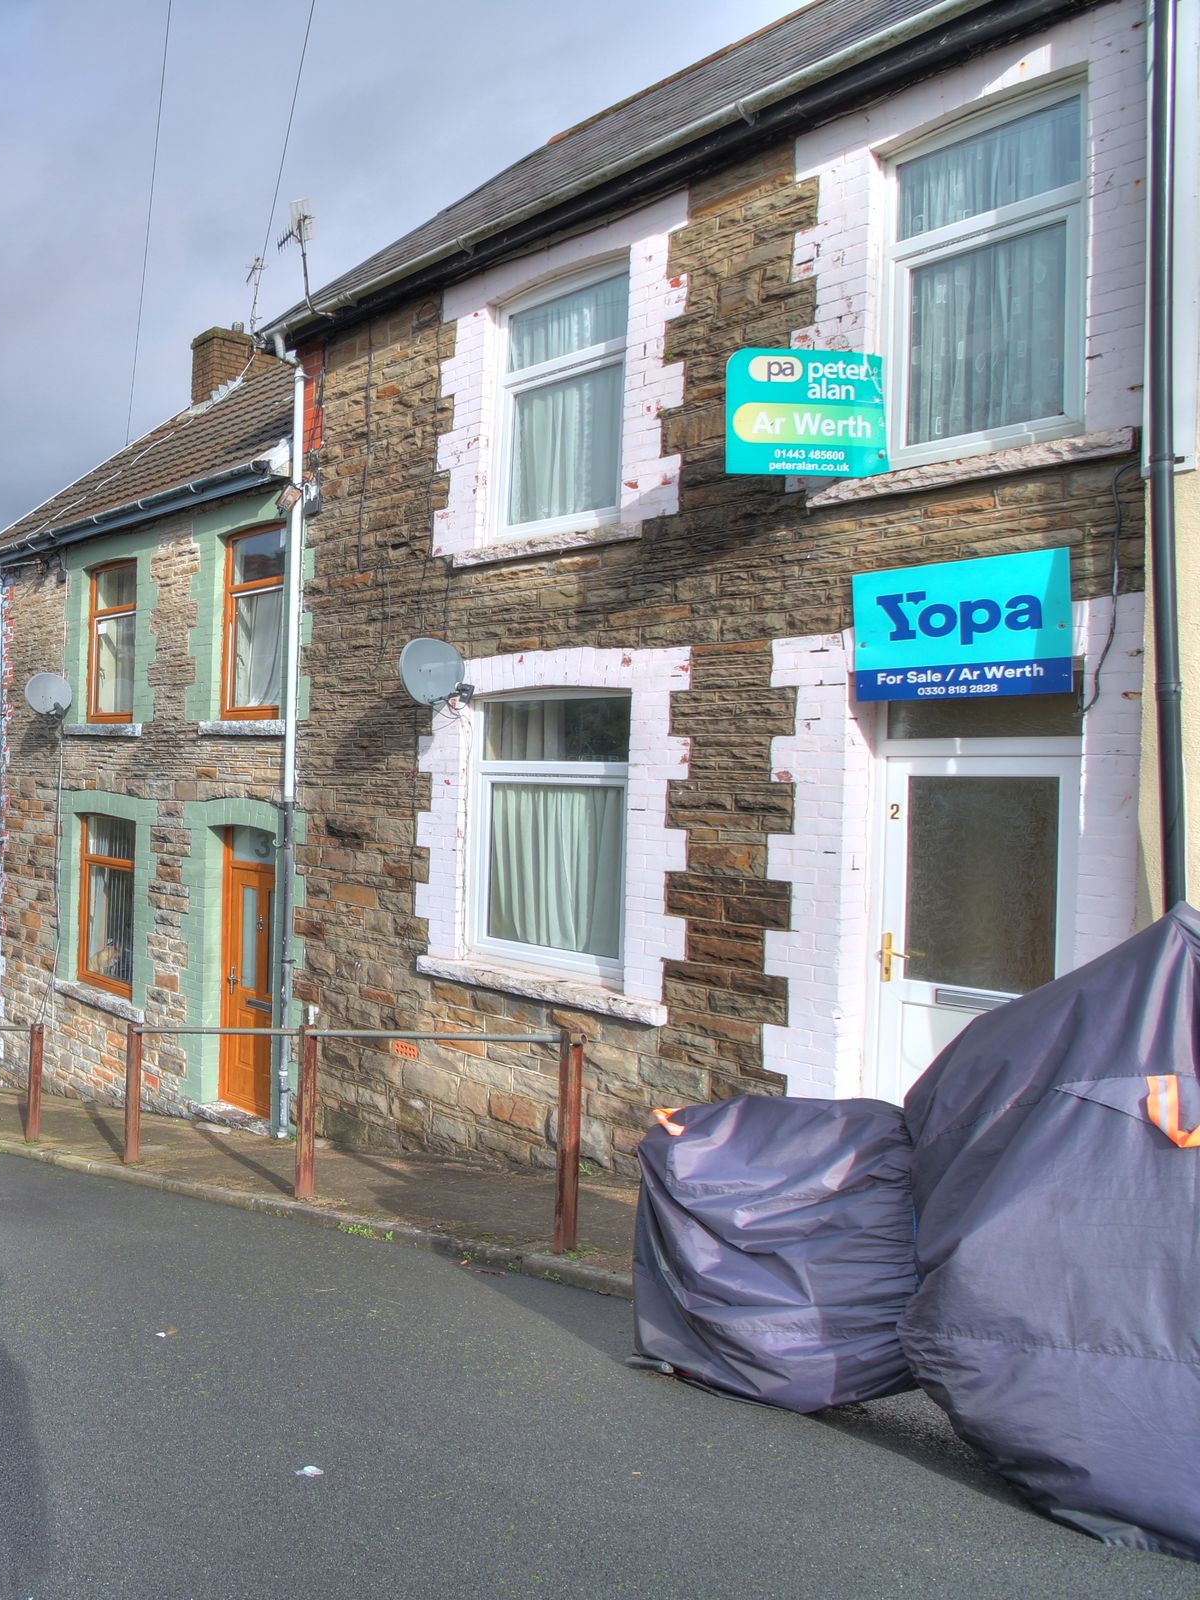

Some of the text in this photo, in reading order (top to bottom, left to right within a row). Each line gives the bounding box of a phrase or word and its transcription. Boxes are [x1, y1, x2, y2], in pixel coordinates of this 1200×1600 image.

[808, 360, 867, 383] peter
[807, 377, 855, 400] alan
[751, 411, 872, 438] Ar Werth
[774, 449, 845, 460] 01443 485600
[769, 461, 850, 472] peteralan.co.uk
[876, 591, 1043, 645] Yopa
[877, 672, 903, 685] For
[907, 670, 942, 683] Sale
[959, 668, 981, 681] Ar
[984, 663, 1044, 679] Werth
[917, 684, 998, 696] 0330 818 2828
[890, 804, 899, 819] 2
[255, 833, 270, 858] 3
